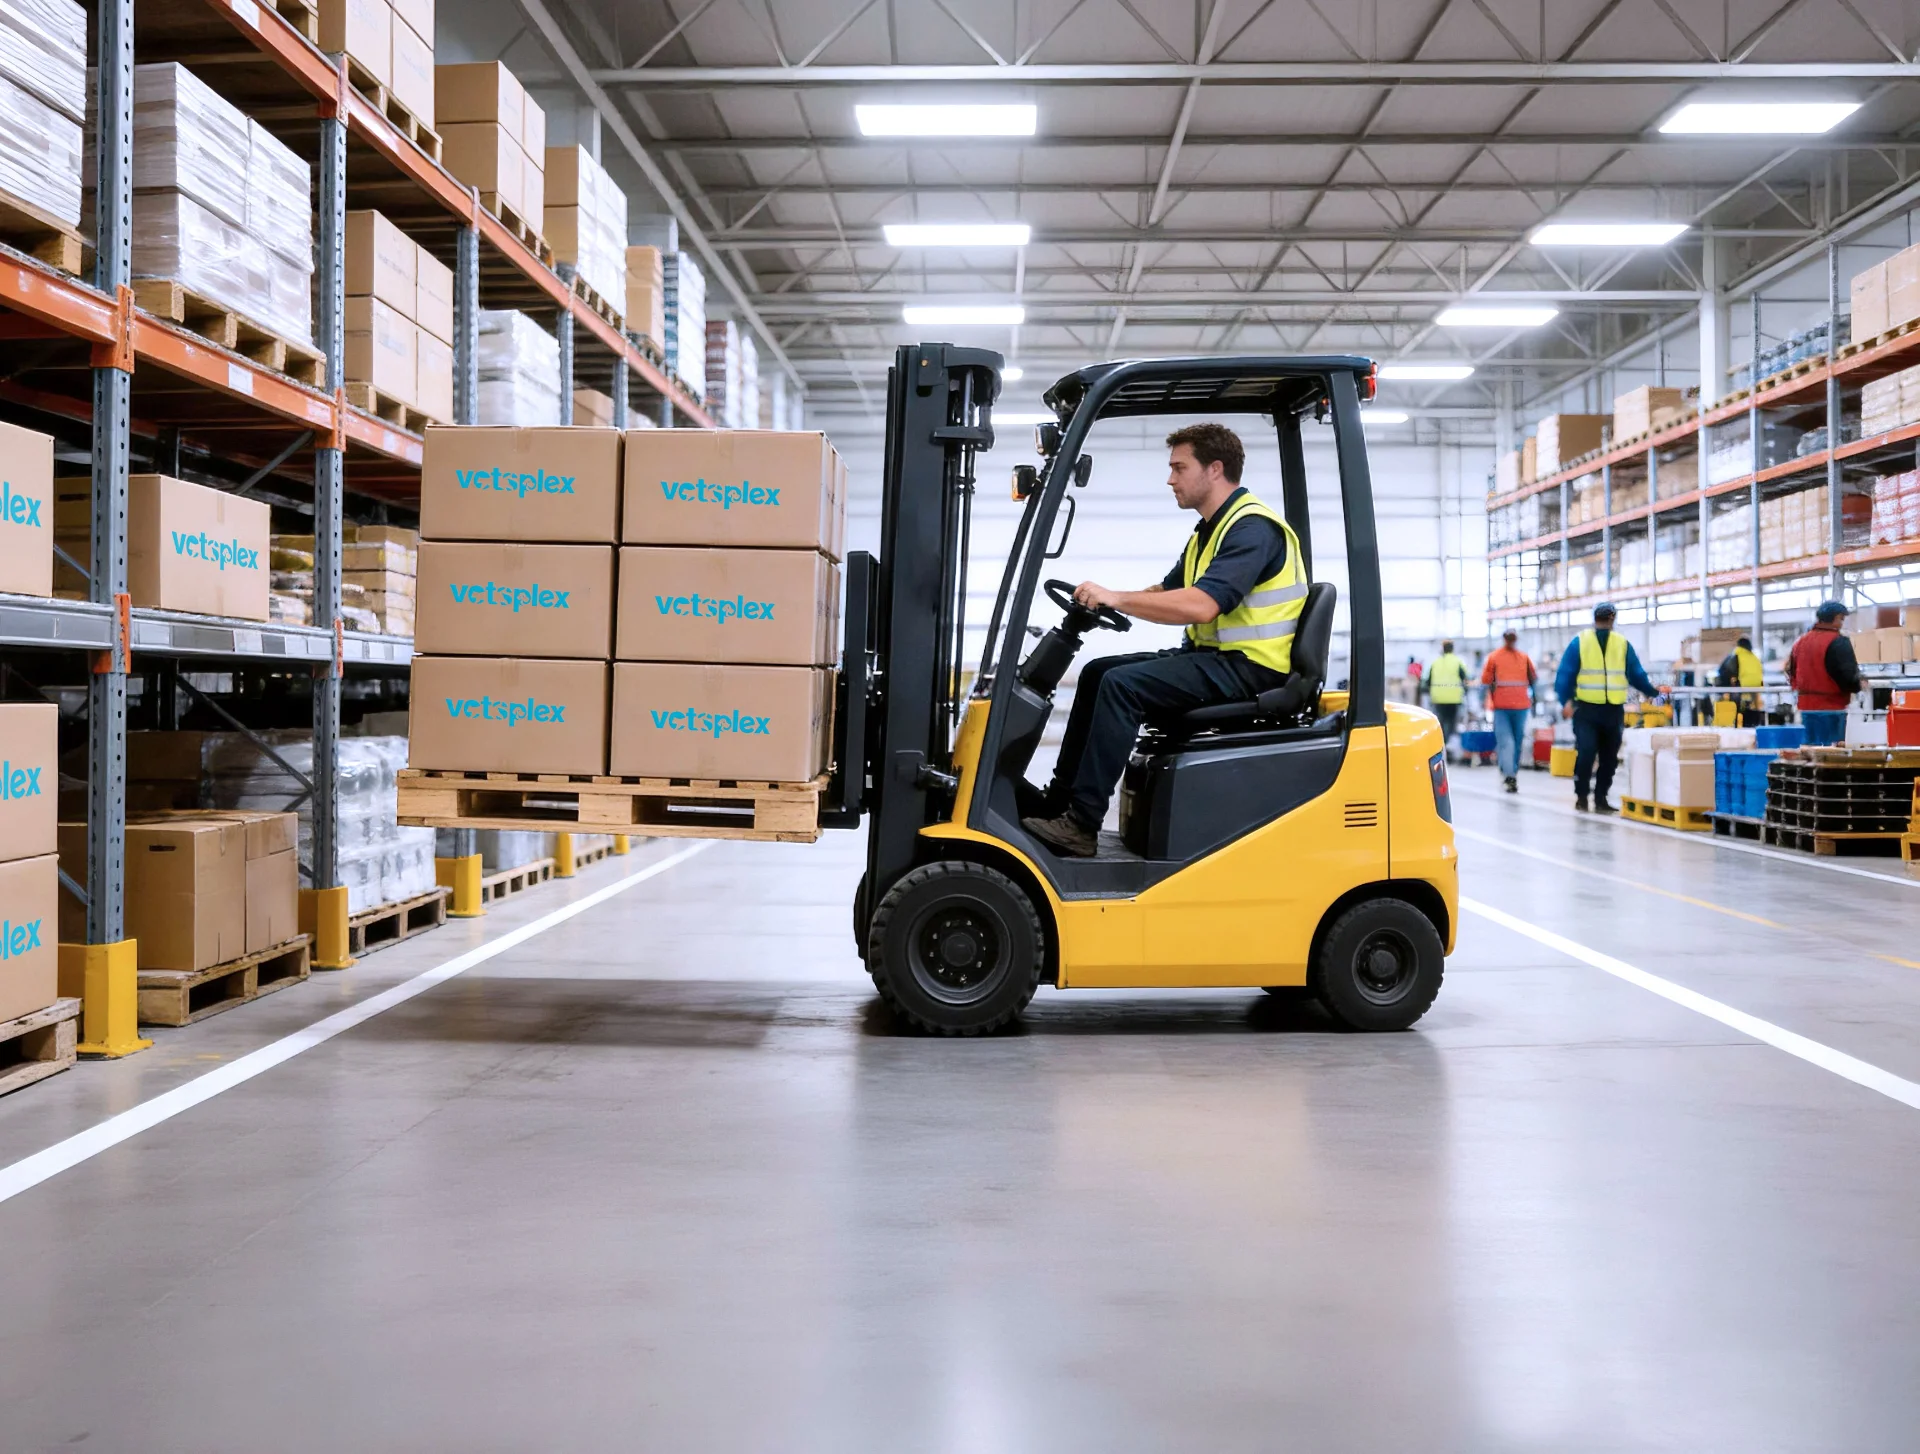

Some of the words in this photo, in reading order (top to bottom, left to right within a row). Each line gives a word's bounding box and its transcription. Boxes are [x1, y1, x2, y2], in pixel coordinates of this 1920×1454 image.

[455, 467, 576, 499] vetsplex
[660, 478, 781, 510] vetsplex
[171, 531, 259, 571] vetsplex
[449, 581, 571, 613] vetsplex
[655, 593, 776, 625] vetsplex
[445, 695, 567, 727] vetsplex
[650, 707, 772, 739] vetsplex
